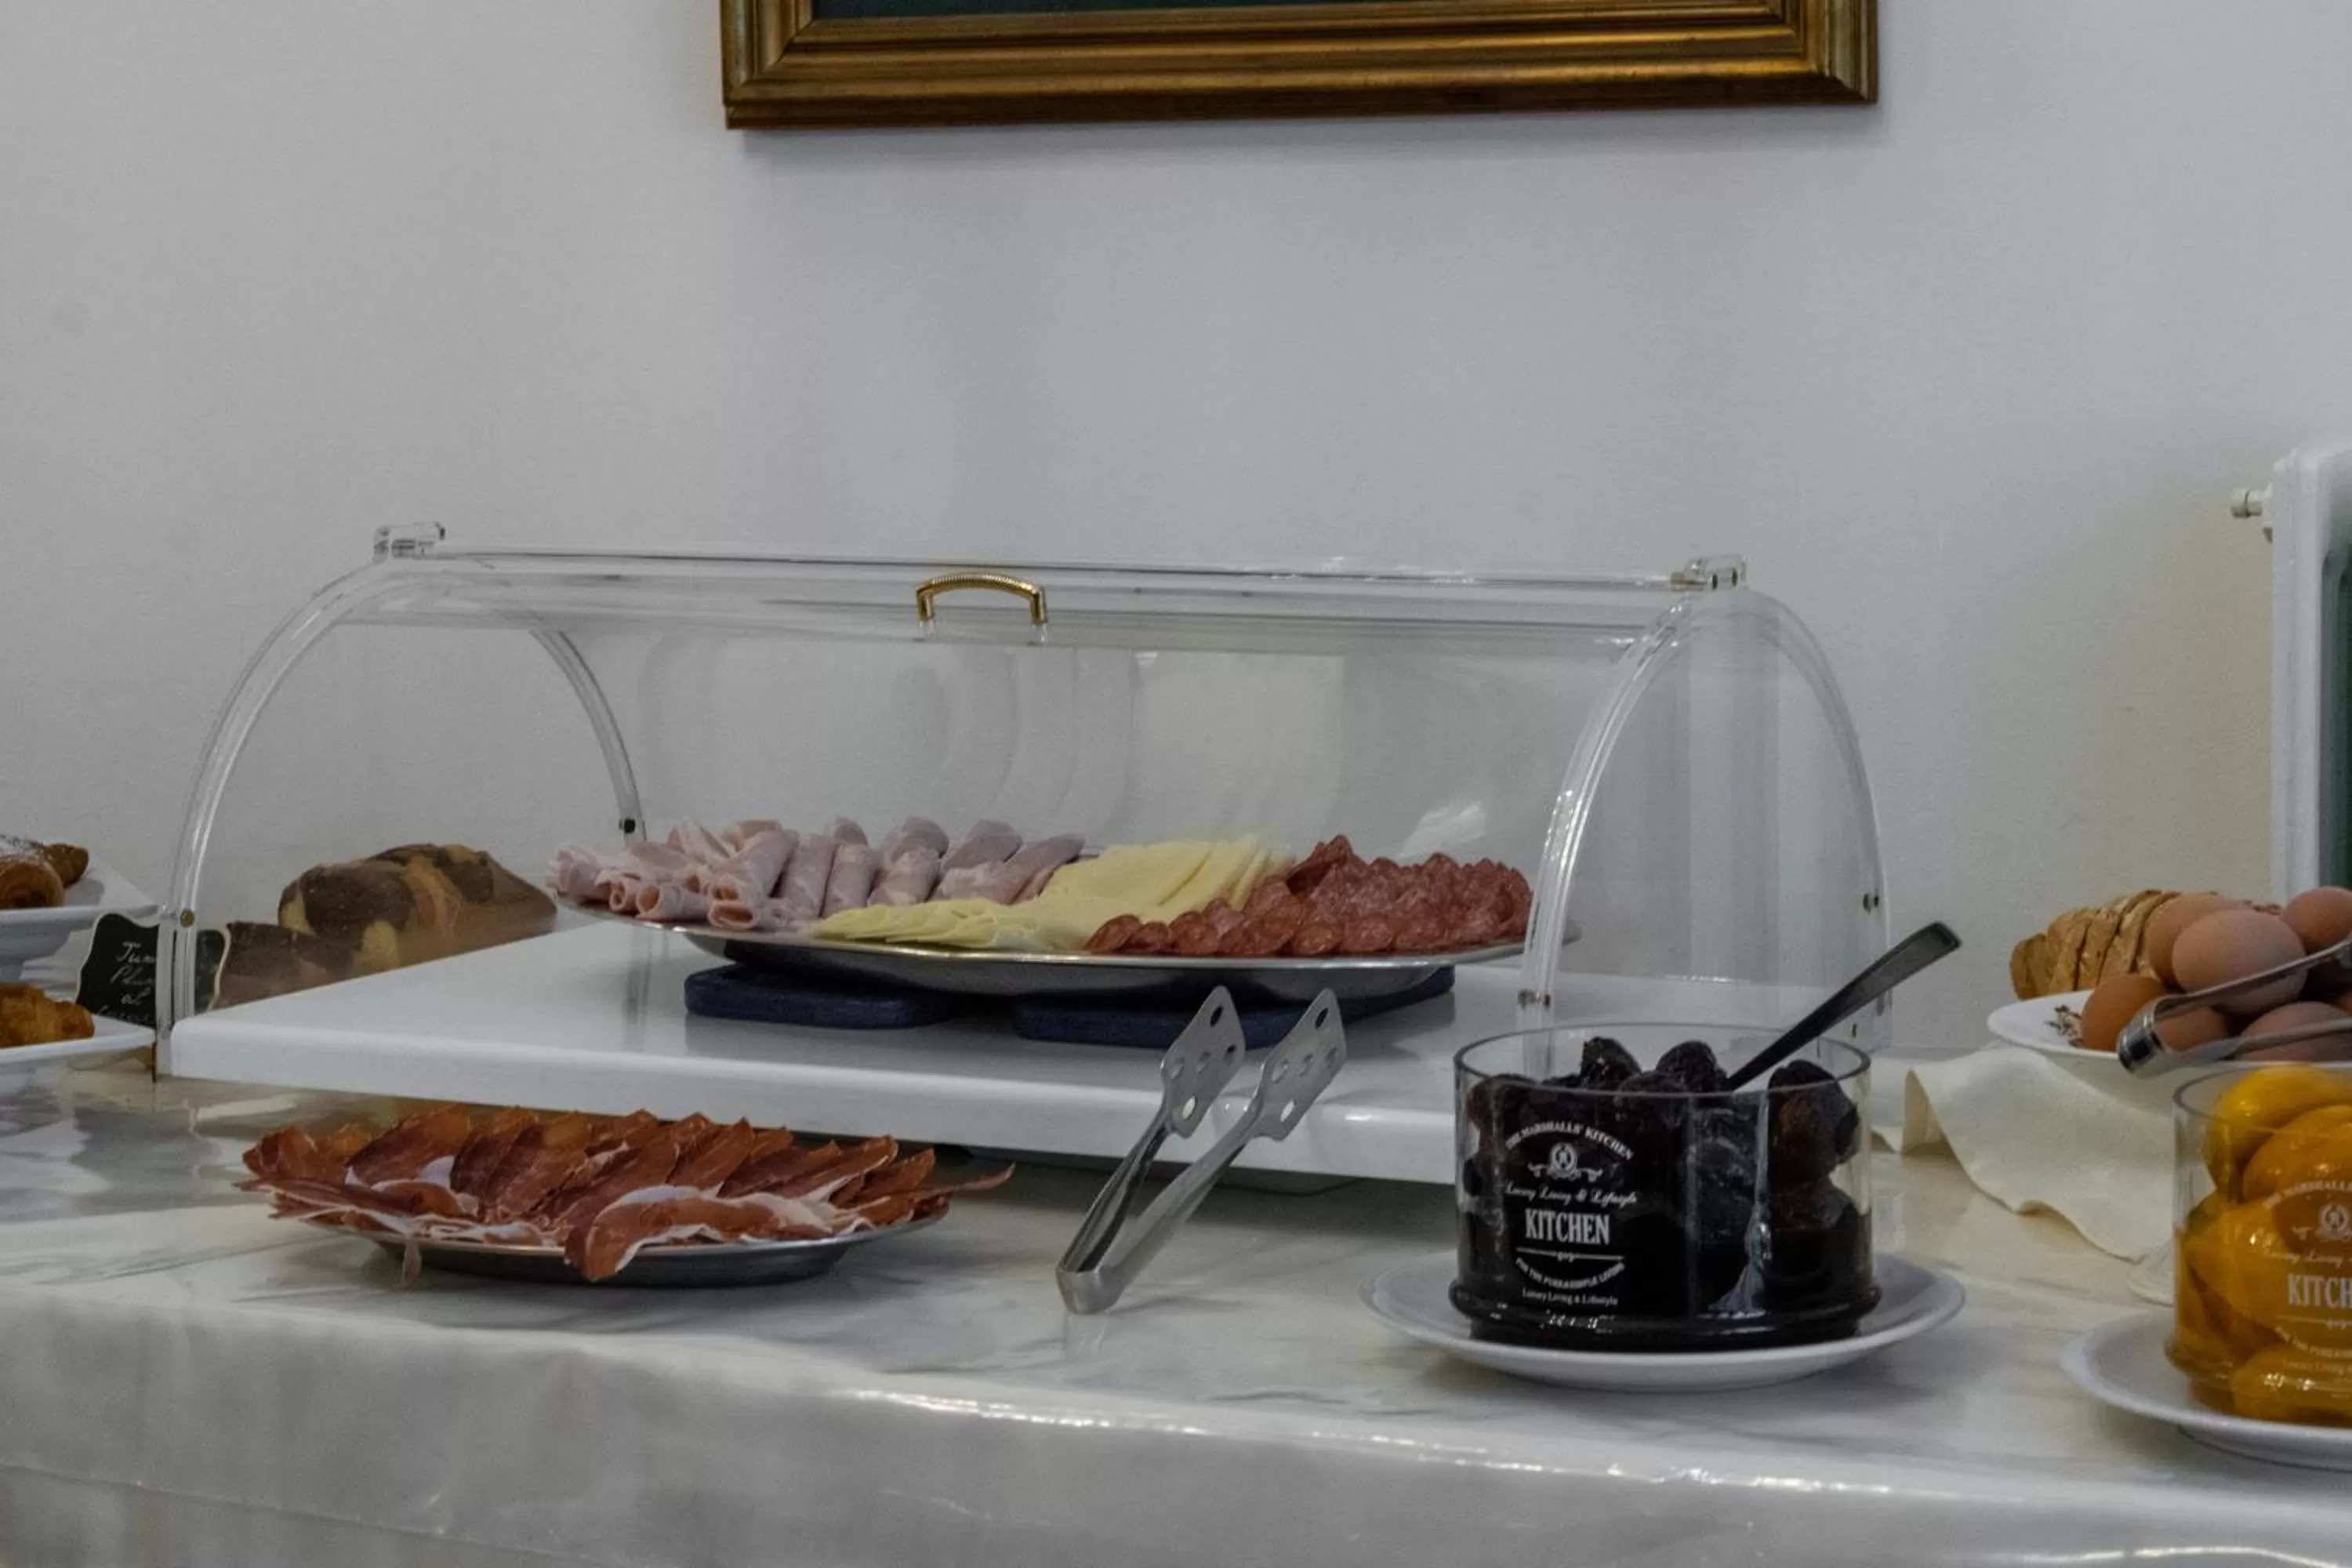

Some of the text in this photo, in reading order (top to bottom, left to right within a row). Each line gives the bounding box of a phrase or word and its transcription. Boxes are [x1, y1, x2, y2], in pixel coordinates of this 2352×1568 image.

[1584, 1126, 1635, 1160] KITCHEN
[1525, 1207, 1610, 1245] KITCHEN
[2287, 1273, 2352, 1308] KITCH
